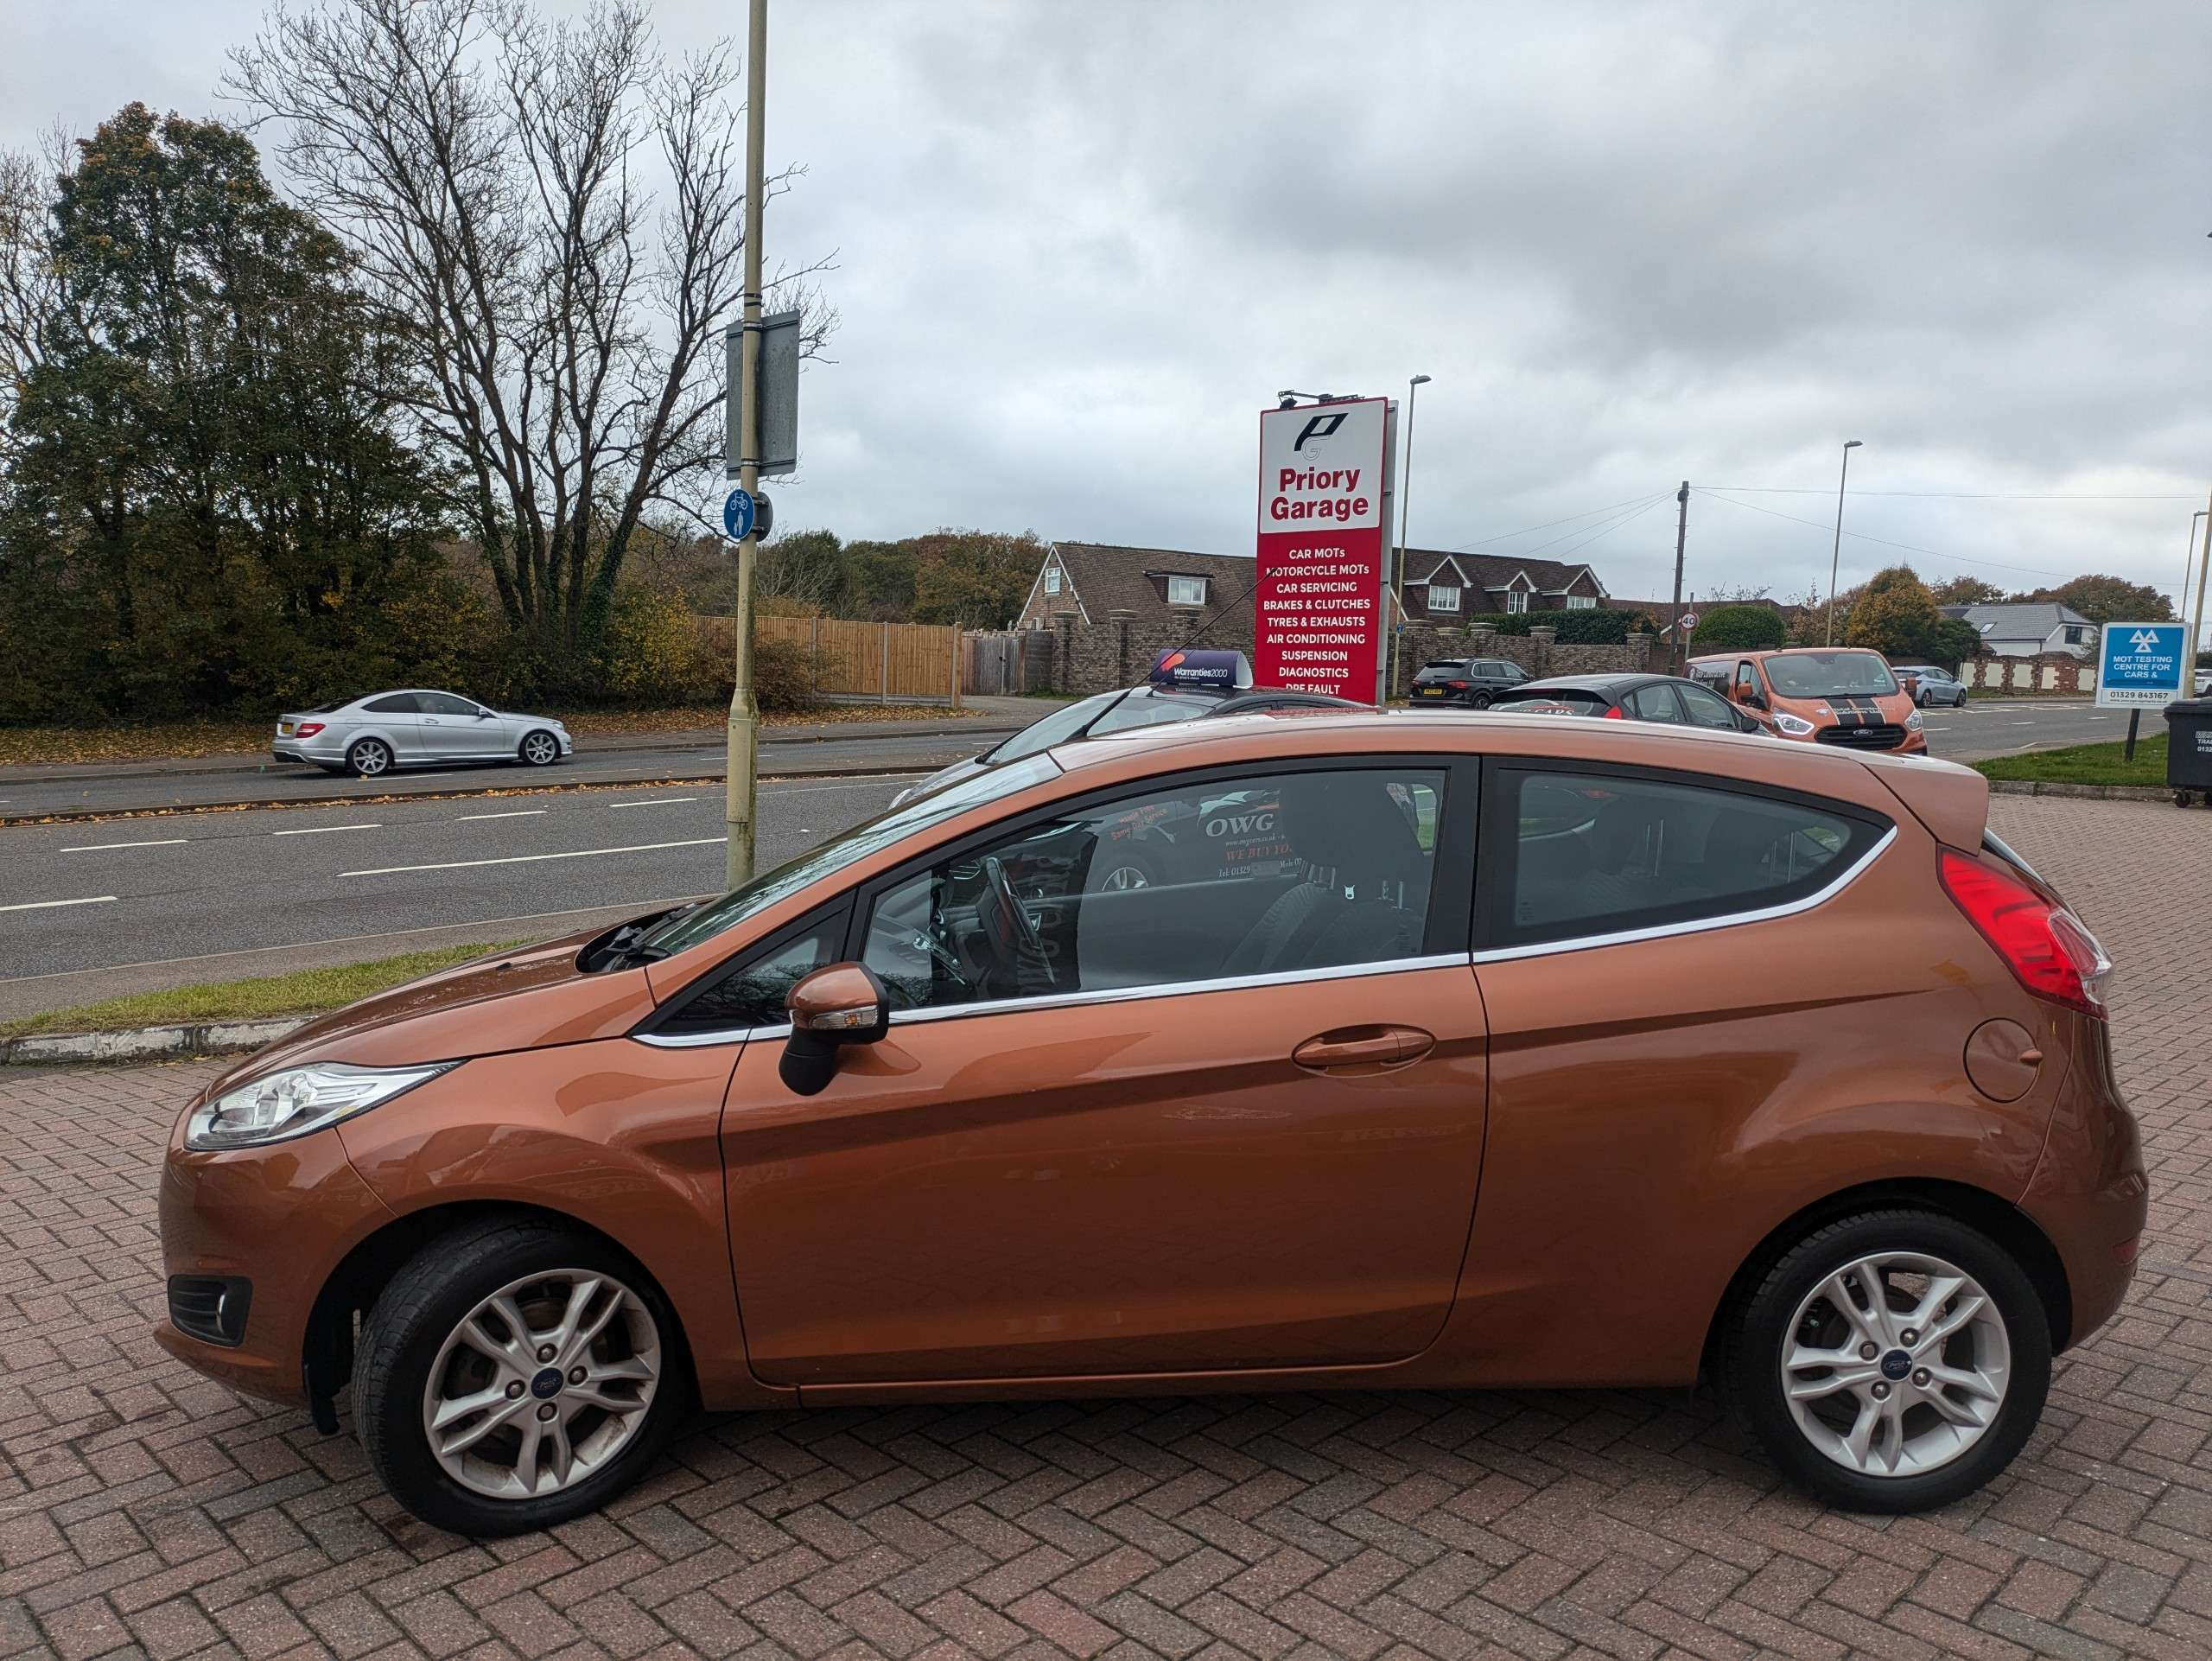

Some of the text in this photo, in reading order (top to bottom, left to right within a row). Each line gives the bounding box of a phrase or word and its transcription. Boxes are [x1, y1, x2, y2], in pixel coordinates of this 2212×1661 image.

[1280, 467, 1361, 492] Priory
[1270, 496, 1369, 522] Garage
[1289, 548, 1345, 559] CAR MOTs
[1267, 564, 1370, 577] MOTORCYCLE MOTs
[1276, 582, 1357, 594] CAR SERVICING
[1263, 599, 1370, 610] BRAKES & CLUTCHES
[1268, 616, 1366, 627] TYRES & EXHAUSTS
[1267, 633, 1365, 645] AIR CONDITIONING
[1281, 650, 1348, 661] SUSPENSION
[1174, 667, 1227, 678] Warranties2000
[1279, 666, 1349, 678] DIAGNOSTICS
[1307, 684, 1341, 695] FAULT
[1205, 813, 1274, 837] OWG
[1225, 843, 1293, 862] WE BUY YO
